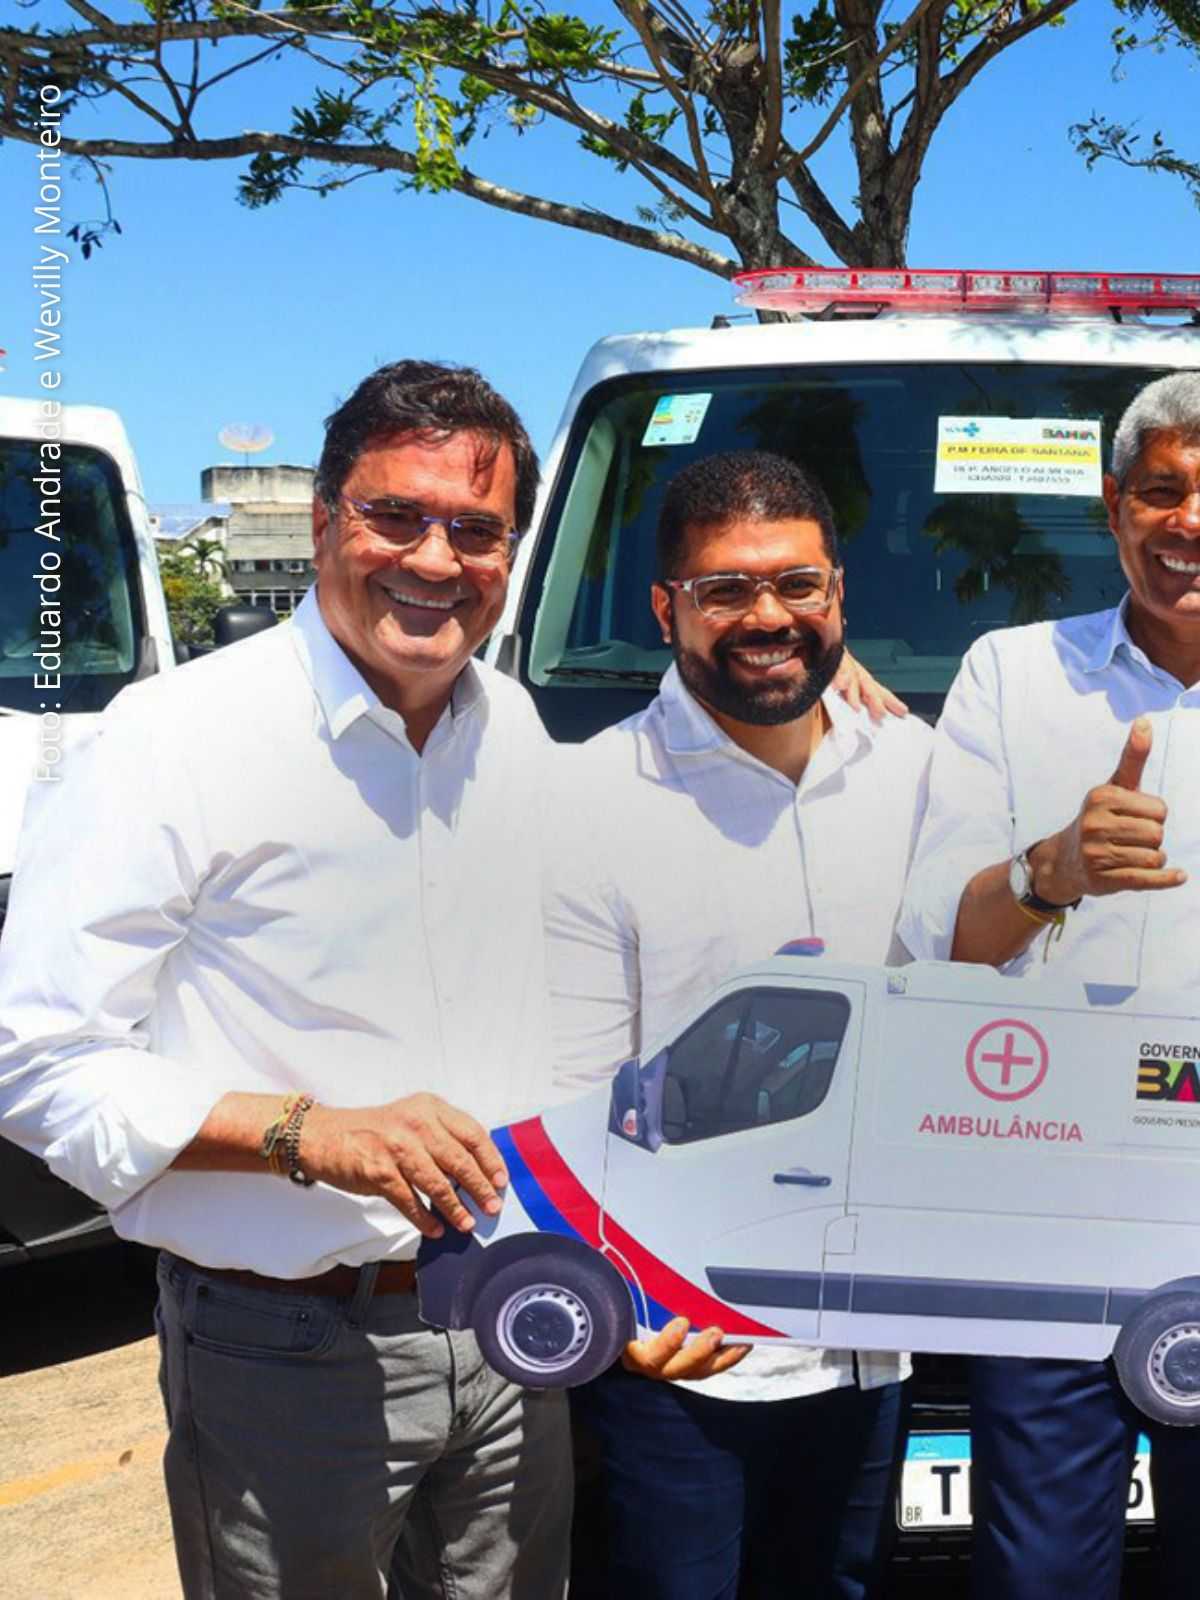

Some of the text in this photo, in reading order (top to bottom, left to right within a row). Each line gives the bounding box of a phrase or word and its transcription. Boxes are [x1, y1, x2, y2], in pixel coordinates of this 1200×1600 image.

[1042, 428, 1097, 441] BAHIA
[1032, 447, 1091, 457] SANTANA
[918, 1113, 1083, 1141] AMBULÂNCIA
[1132, 1115, 1174, 1127] GOVERNO
[904, 1505, 923, 1523] BR
